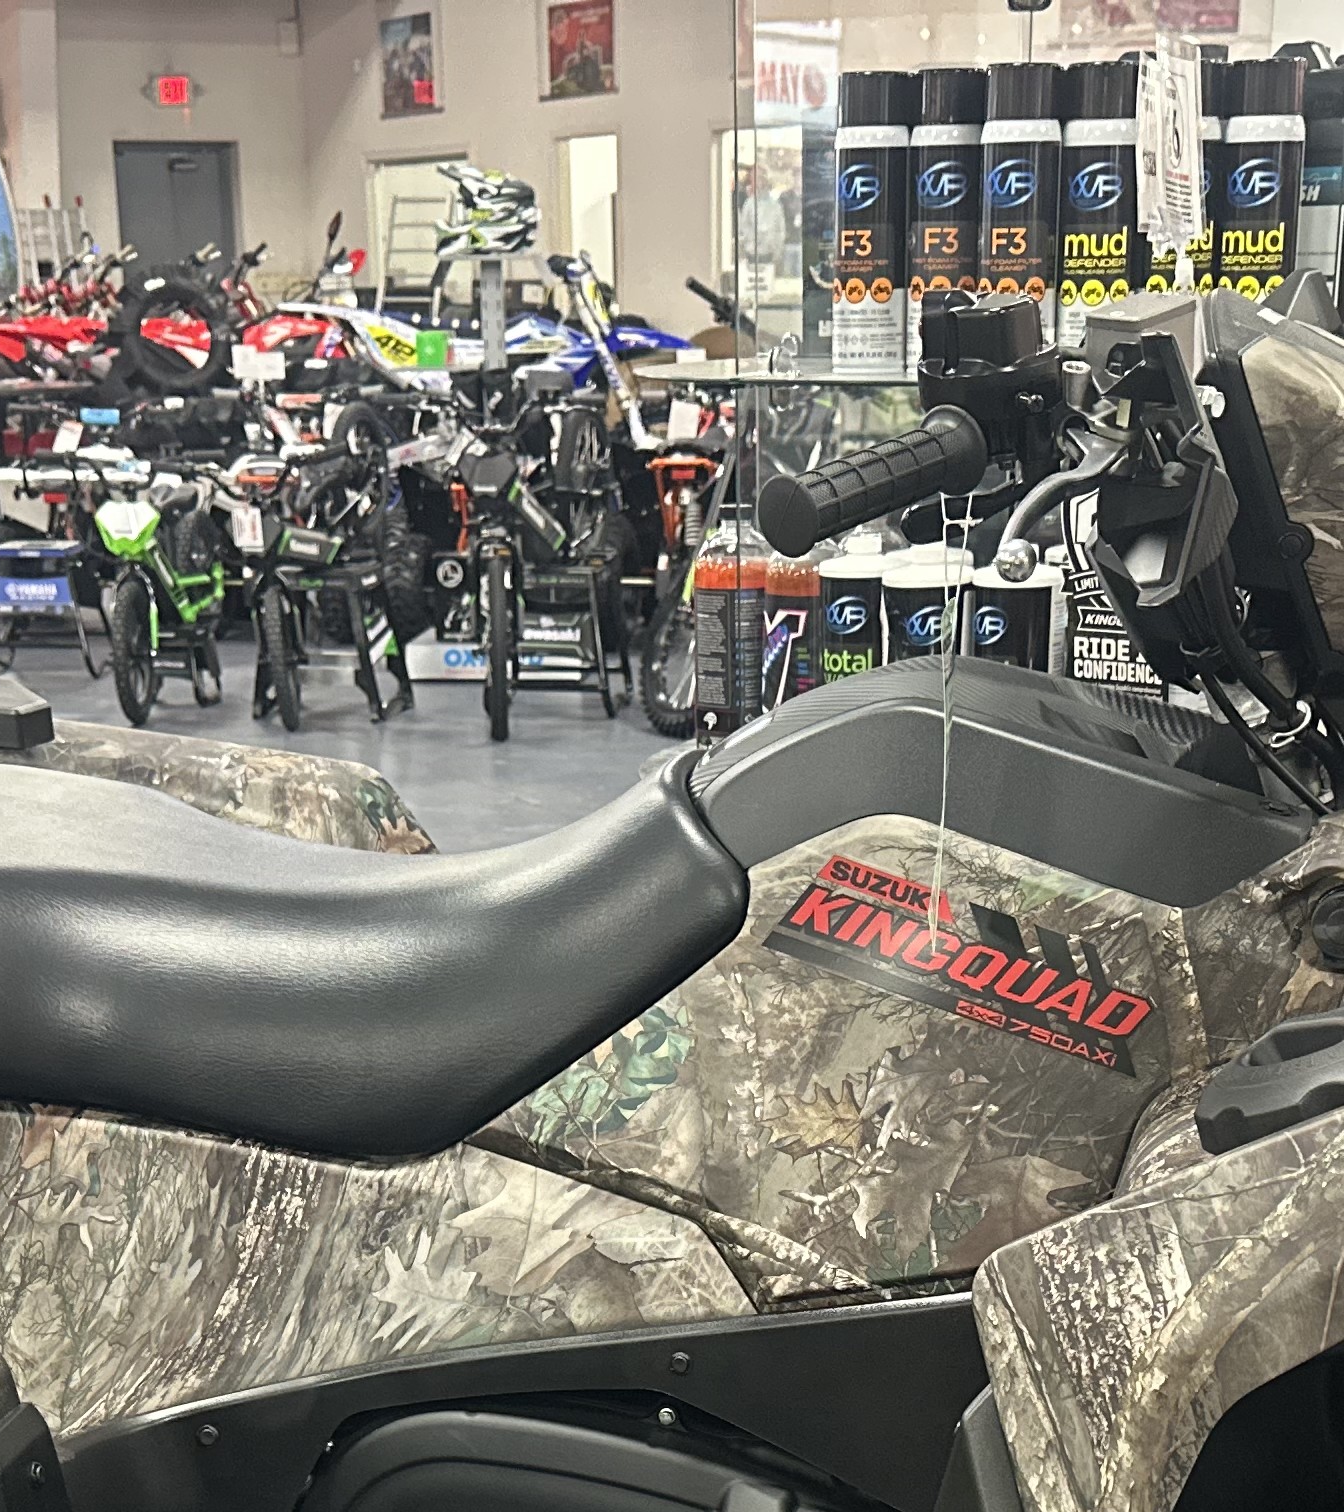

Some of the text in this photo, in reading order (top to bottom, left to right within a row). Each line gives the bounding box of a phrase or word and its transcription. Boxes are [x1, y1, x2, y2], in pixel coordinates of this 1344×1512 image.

[841, 229, 872, 257] F3
[924, 227, 959, 254] F3
[991, 227, 1027, 256] F3
[1064, 225, 1128, 257] mud
[1221, 222, 1285, 252] mud
[1063, 258, 1126, 268] DEFENDER
[1220, 254, 1282, 264] DEFENDER
[1074, 576, 1099, 592] LIMIT
[823, 648, 873, 673] total
[1073, 636, 1130, 662] RIDE
[789, 888, 1153, 1036] KINGQUAD
[958, 1003, 1118, 1067] 4x4 750AXi
